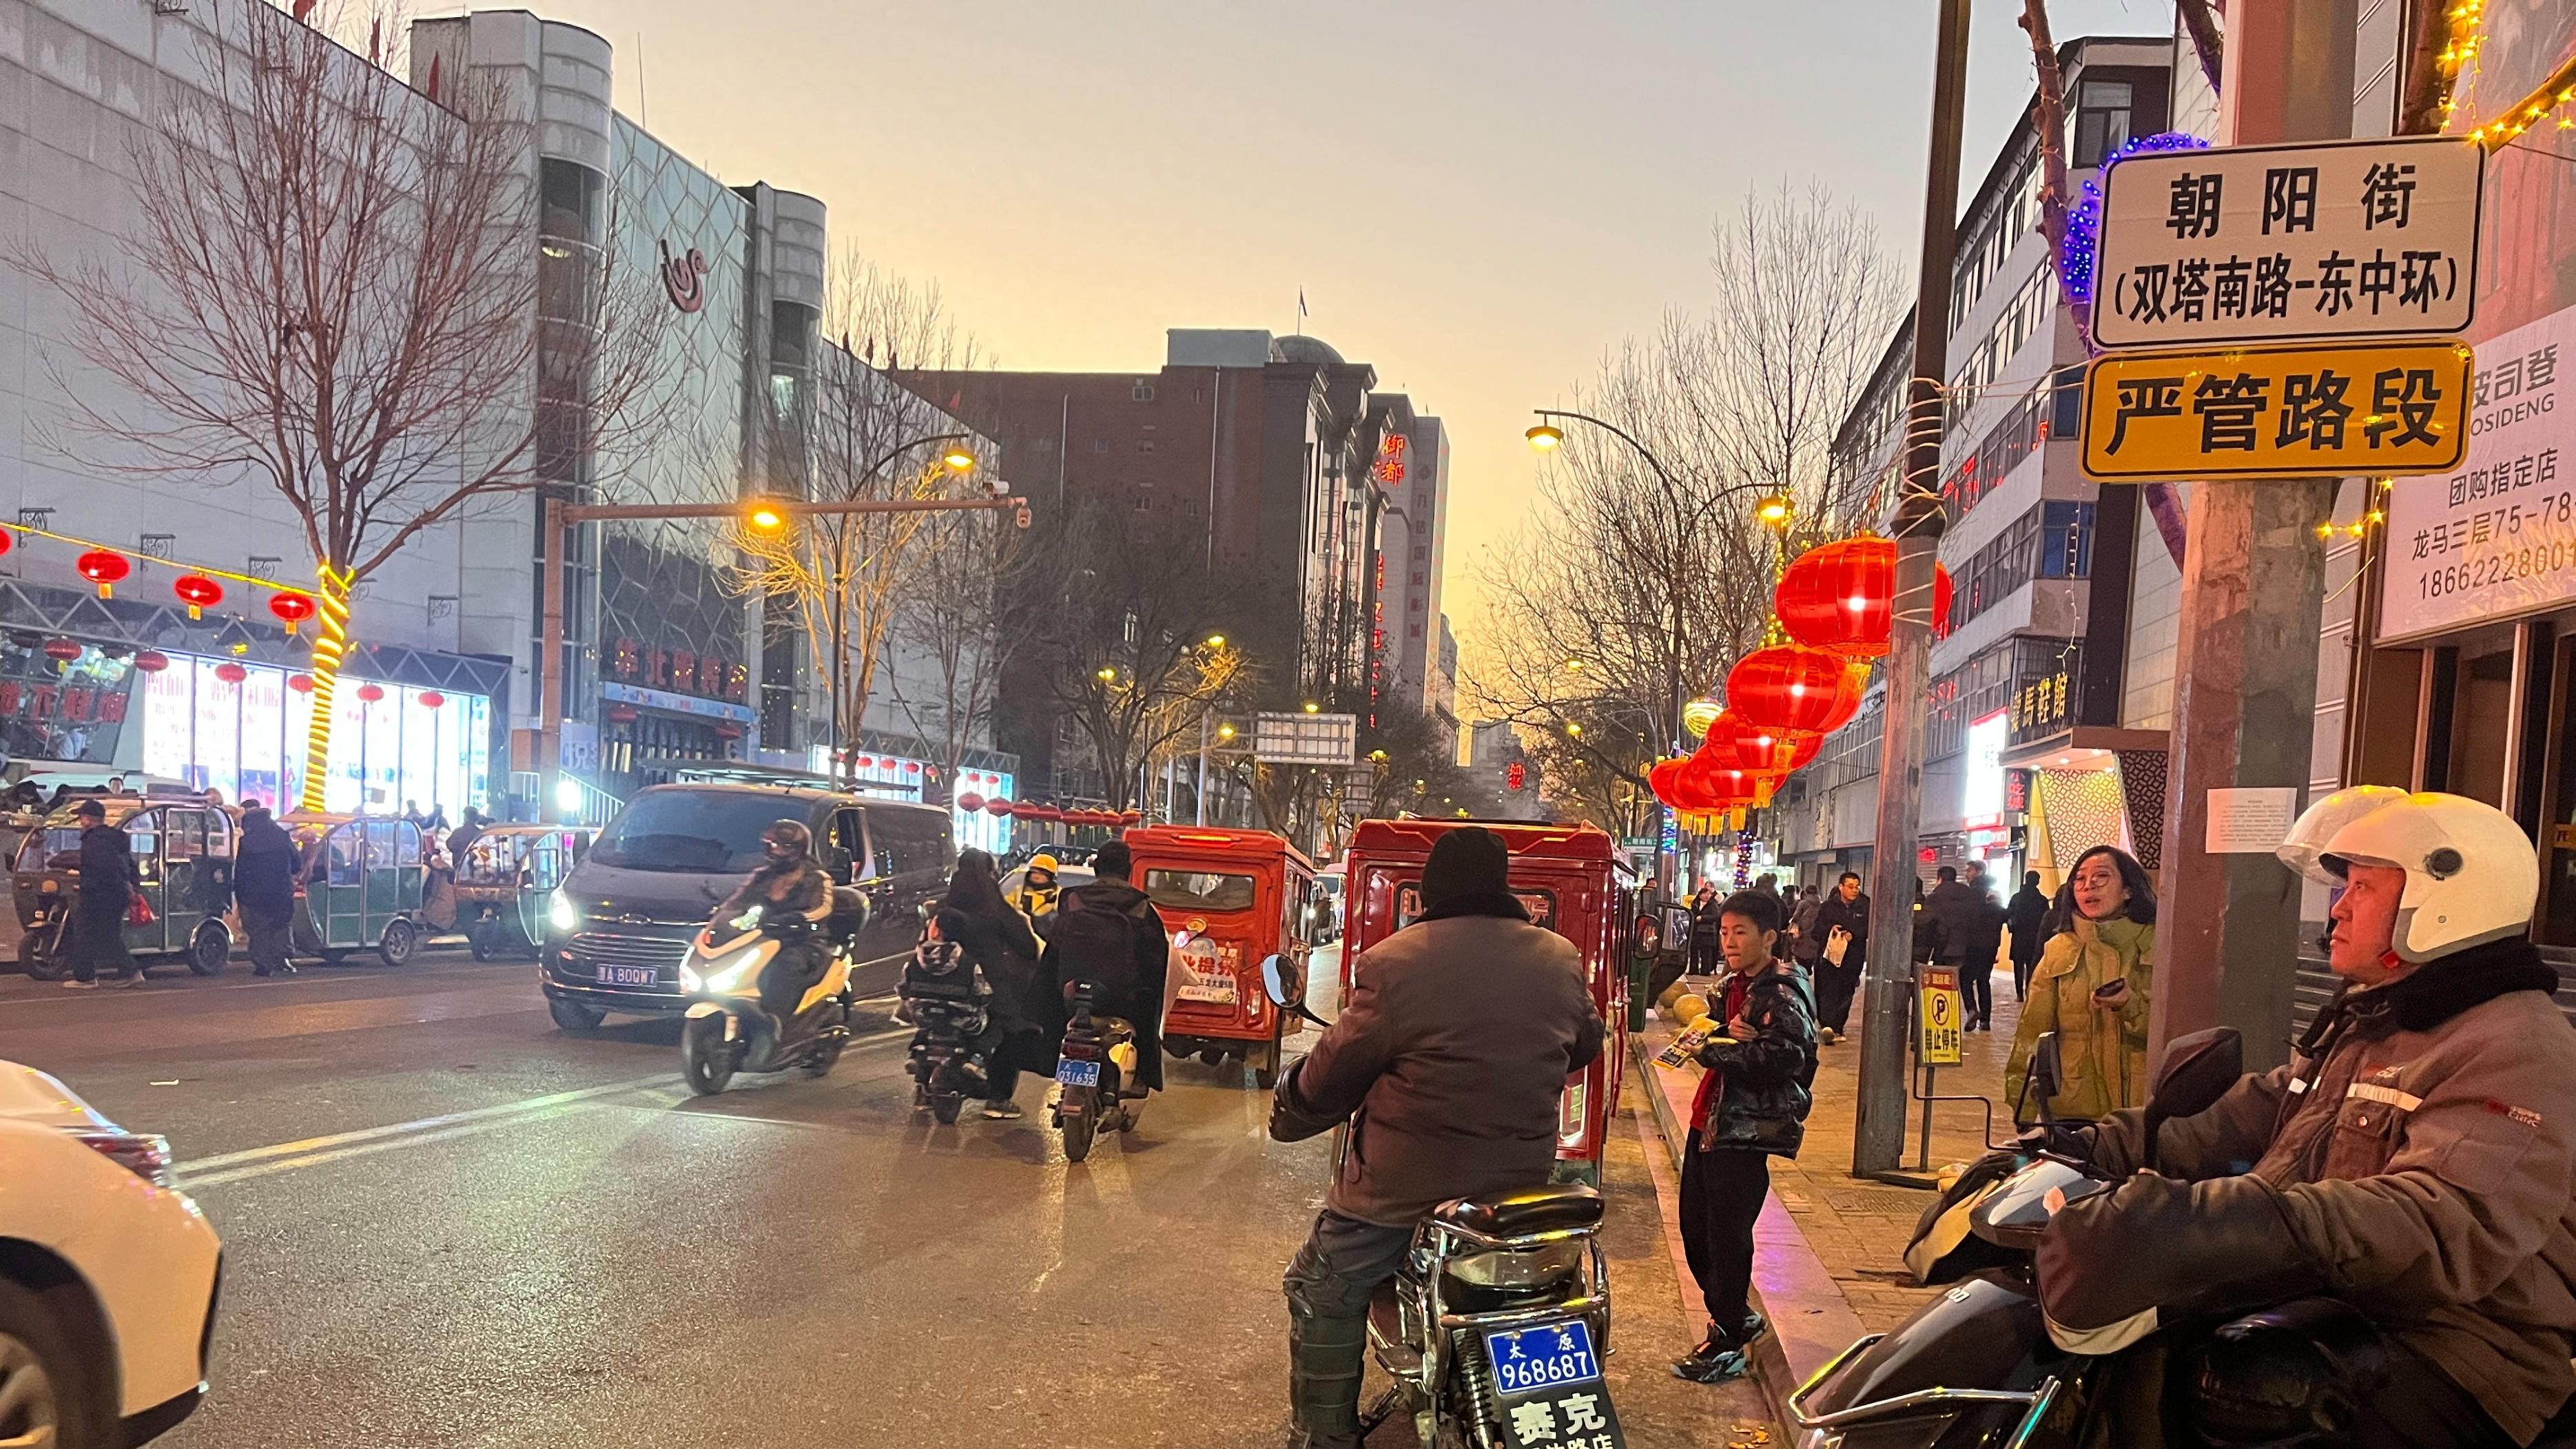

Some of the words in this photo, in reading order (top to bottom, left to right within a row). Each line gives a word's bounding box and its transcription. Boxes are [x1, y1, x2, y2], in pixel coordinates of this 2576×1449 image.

[2166, 163, 2416, 238] 朝阳街
[2114, 249, 2457, 325] (双塔南路-东中环)
[2104, 367, 2442, 457] 严管路段
[2470, 393, 2555, 436] OSIDENG
[1381, 434, 1405, 486] 御都
[2449, 447, 2558, 508] 团购指定店
[2412, 491, 2576, 561] 龙马三层75-78
[1058, 1070, 1095, 1085] 031635
[1502, 1351, 1587, 1388] 968687
[1509, 1333, 1575, 1360] 太原
[1509, 1393, 1606, 1446] 赛克
